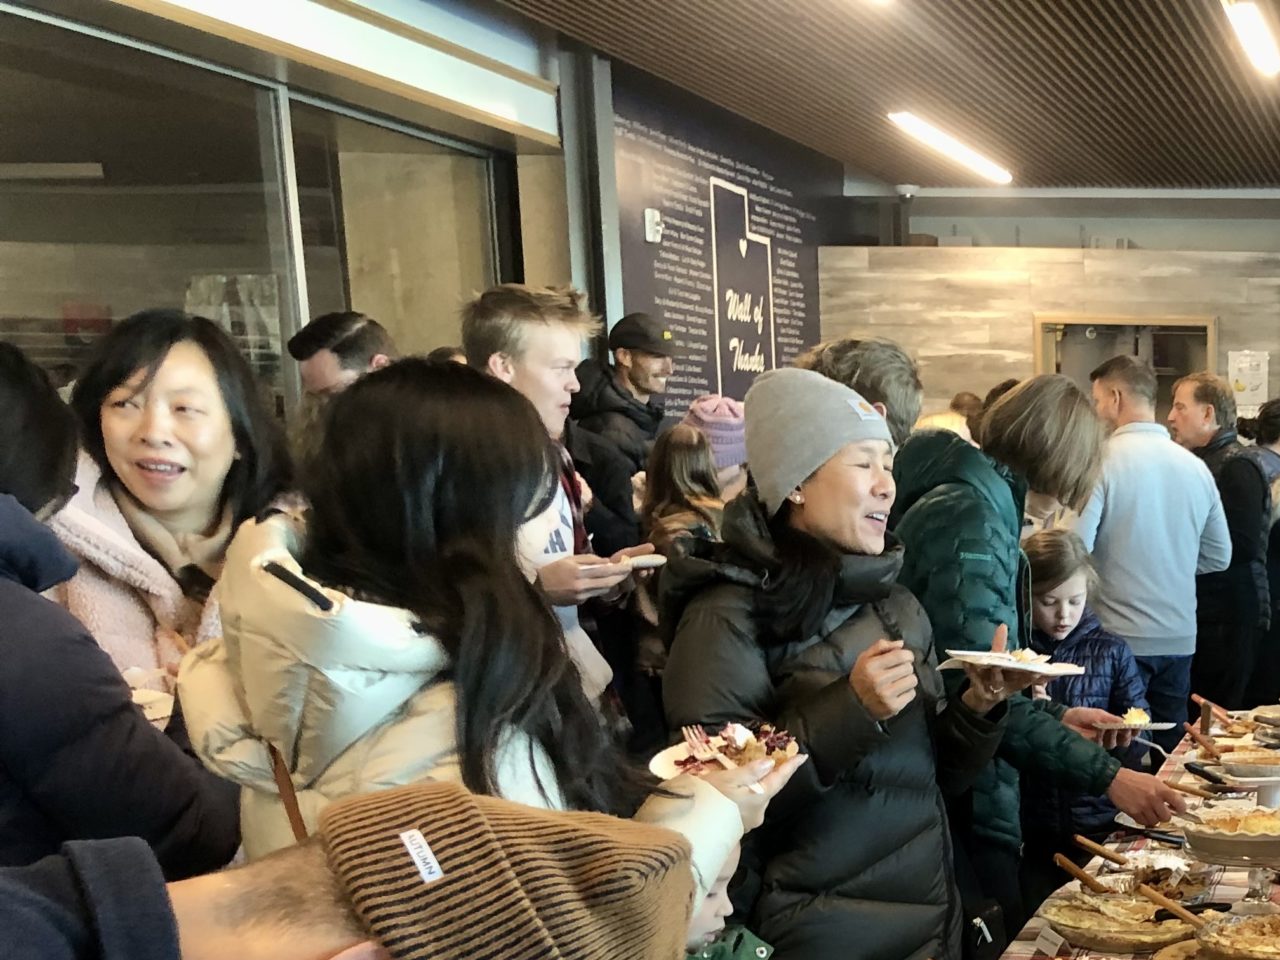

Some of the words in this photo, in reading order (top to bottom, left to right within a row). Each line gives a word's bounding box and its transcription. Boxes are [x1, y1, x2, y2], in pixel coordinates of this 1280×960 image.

[726, 289, 752, 323] Wall
[753, 295, 764, 335] of
[729, 337, 765, 373] Thanks
[407, 834, 436, 875] AUTUMN
